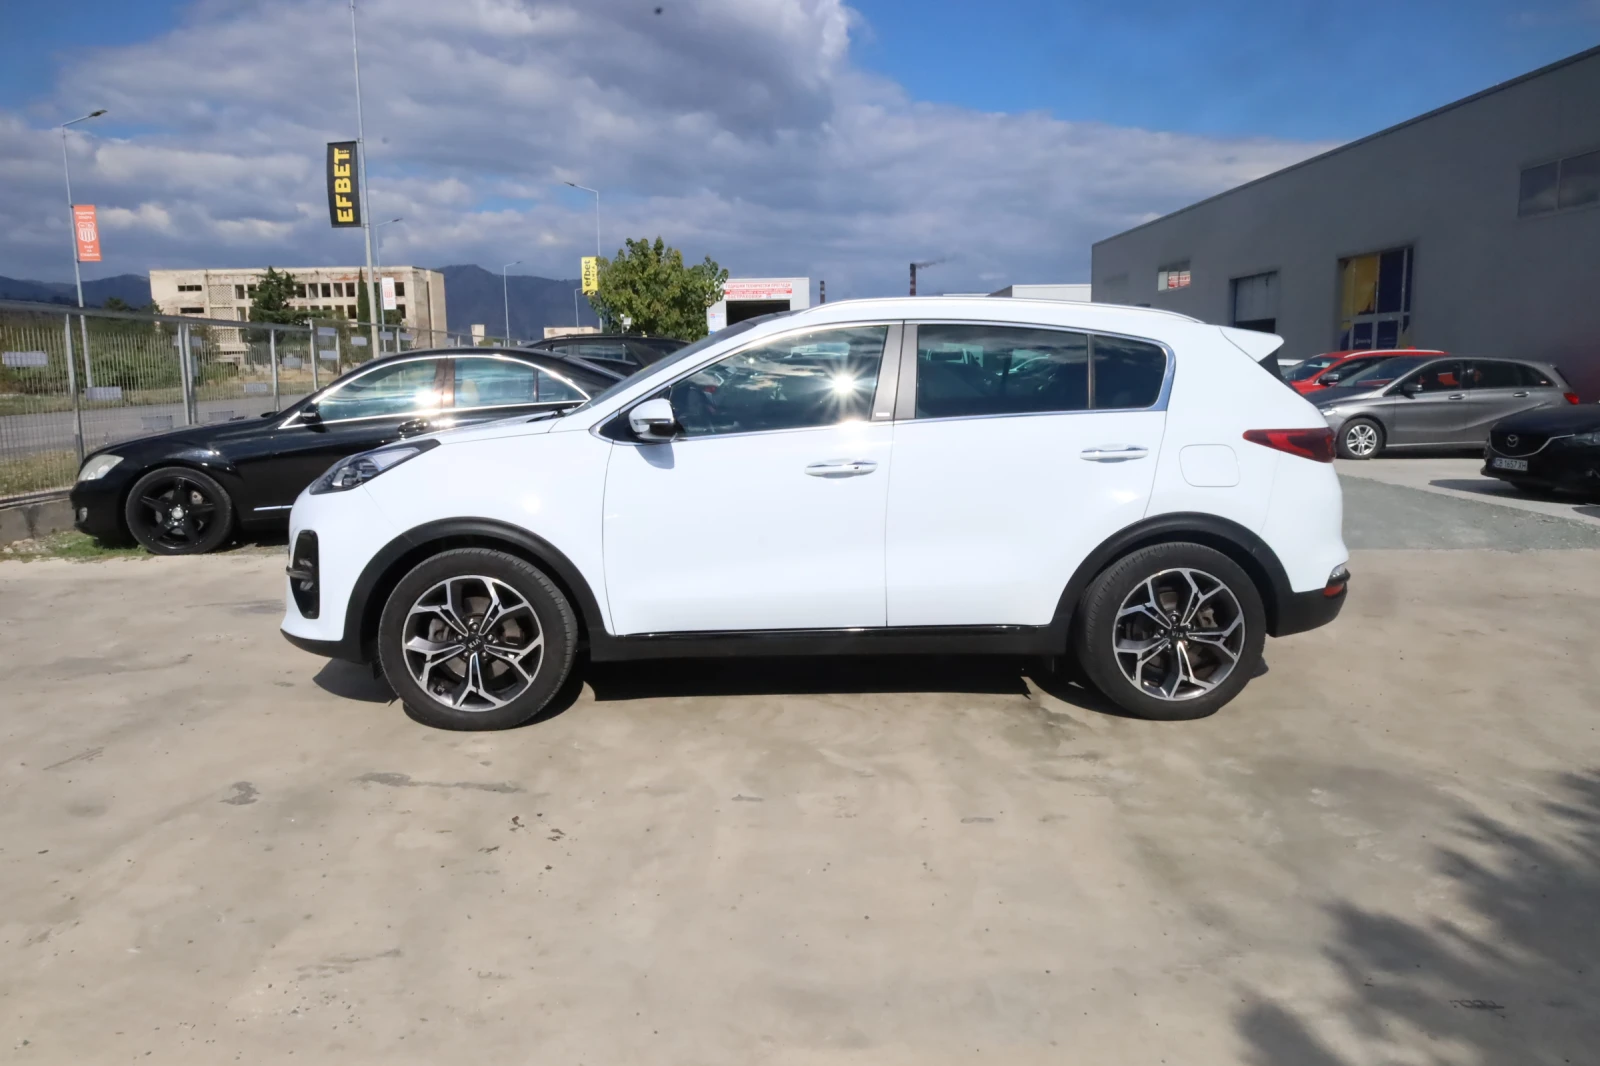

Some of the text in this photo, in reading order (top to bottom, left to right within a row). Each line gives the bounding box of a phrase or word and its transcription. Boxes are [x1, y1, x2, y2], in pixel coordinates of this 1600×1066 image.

[333, 147, 354, 223] EFBET
[584, 260, 592, 287] efbet
[1504, 460, 1518, 469] 1657
[468, 638, 482, 649] KIA
